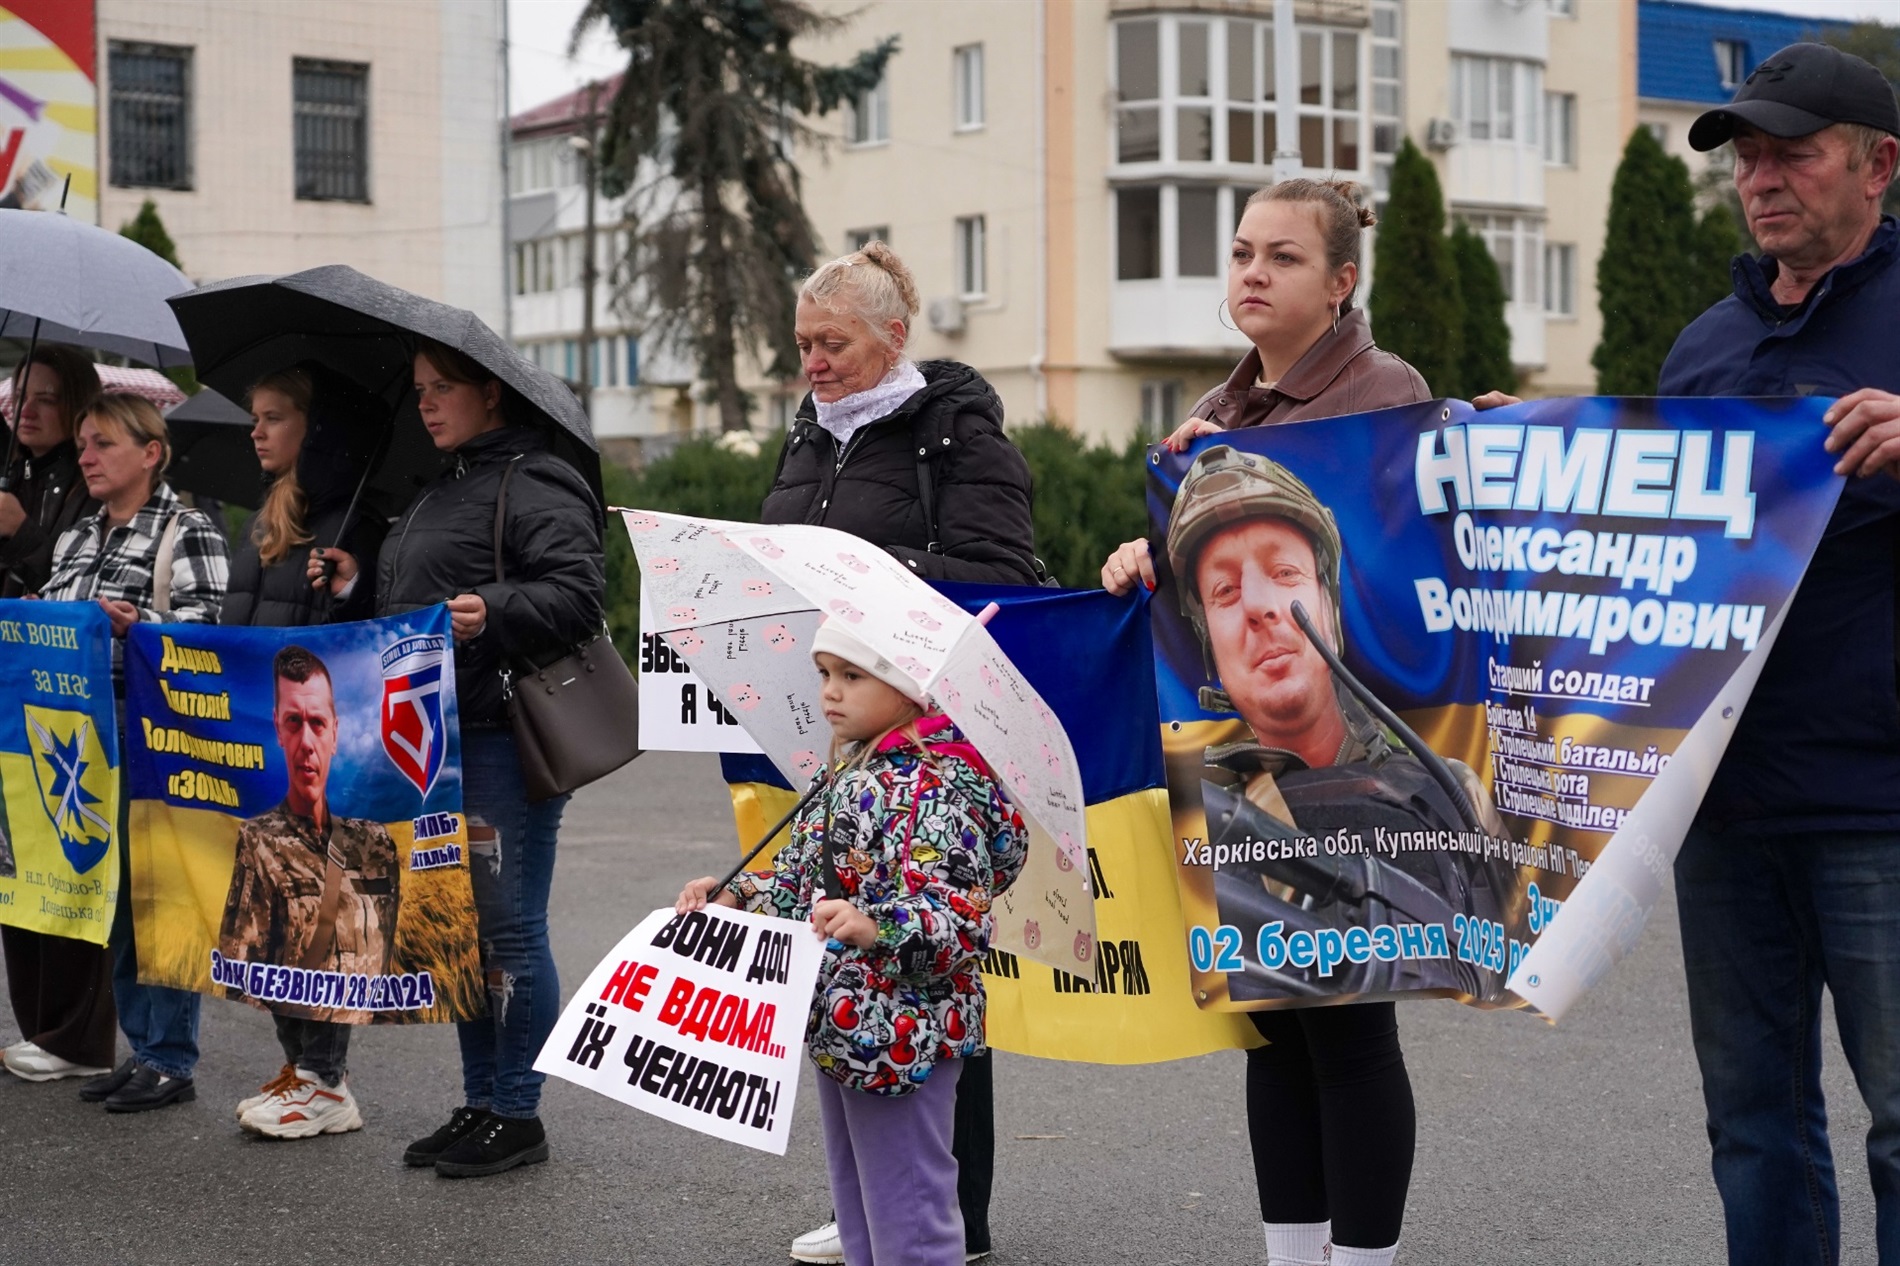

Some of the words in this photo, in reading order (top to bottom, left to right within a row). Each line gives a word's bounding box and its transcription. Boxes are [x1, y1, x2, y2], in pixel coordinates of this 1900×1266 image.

[1415, 424, 1756, 539] НЕМЕЦ
[1453, 512, 1698, 596] Олександр
[0, 620, 25, 643] ЯК
[26, 622, 79, 650] ВОНИ
[1414, 577, 1766, 656] Володимирович
[681, 683, 697, 725] Я
[1488, 656, 1543, 696] Старший
[1549, 669, 1656, 704] солдат
[1486, 700, 1524, 731] Бригада
[1524, 705, 1537, 731] 14
[1553, 773, 1589, 798] рота
[1182, 836, 1317, 871] Харківська
[1324, 828, 1370, 858] обл,
[1374, 827, 1481, 859] Купянський
[1484, 836, 1500, 862] р-н
[1503, 840, 1510, 861] в
[1511, 837, 1548, 869] районі
[1549, 843, 1566, 875] НП
[1527, 881, 1565, 935] Зн
[650, 911, 749, 973] ВОНИ
[745, 929, 793, 985] ДОСІ
[1189, 924, 1245, 973] 02
[1257, 921, 1450, 977] березня
[1453, 913, 1505, 974] 2025
[249, 962, 346, 1008] БЕЗВІСТИ
[599, 960, 660, 1012] НЕ
[656, 976, 786, 1059] ВДОМА...
[566, 1002, 618, 1071] ЇХ
[623, 1034, 781, 1132] ЧЕКАЮТЬ!
